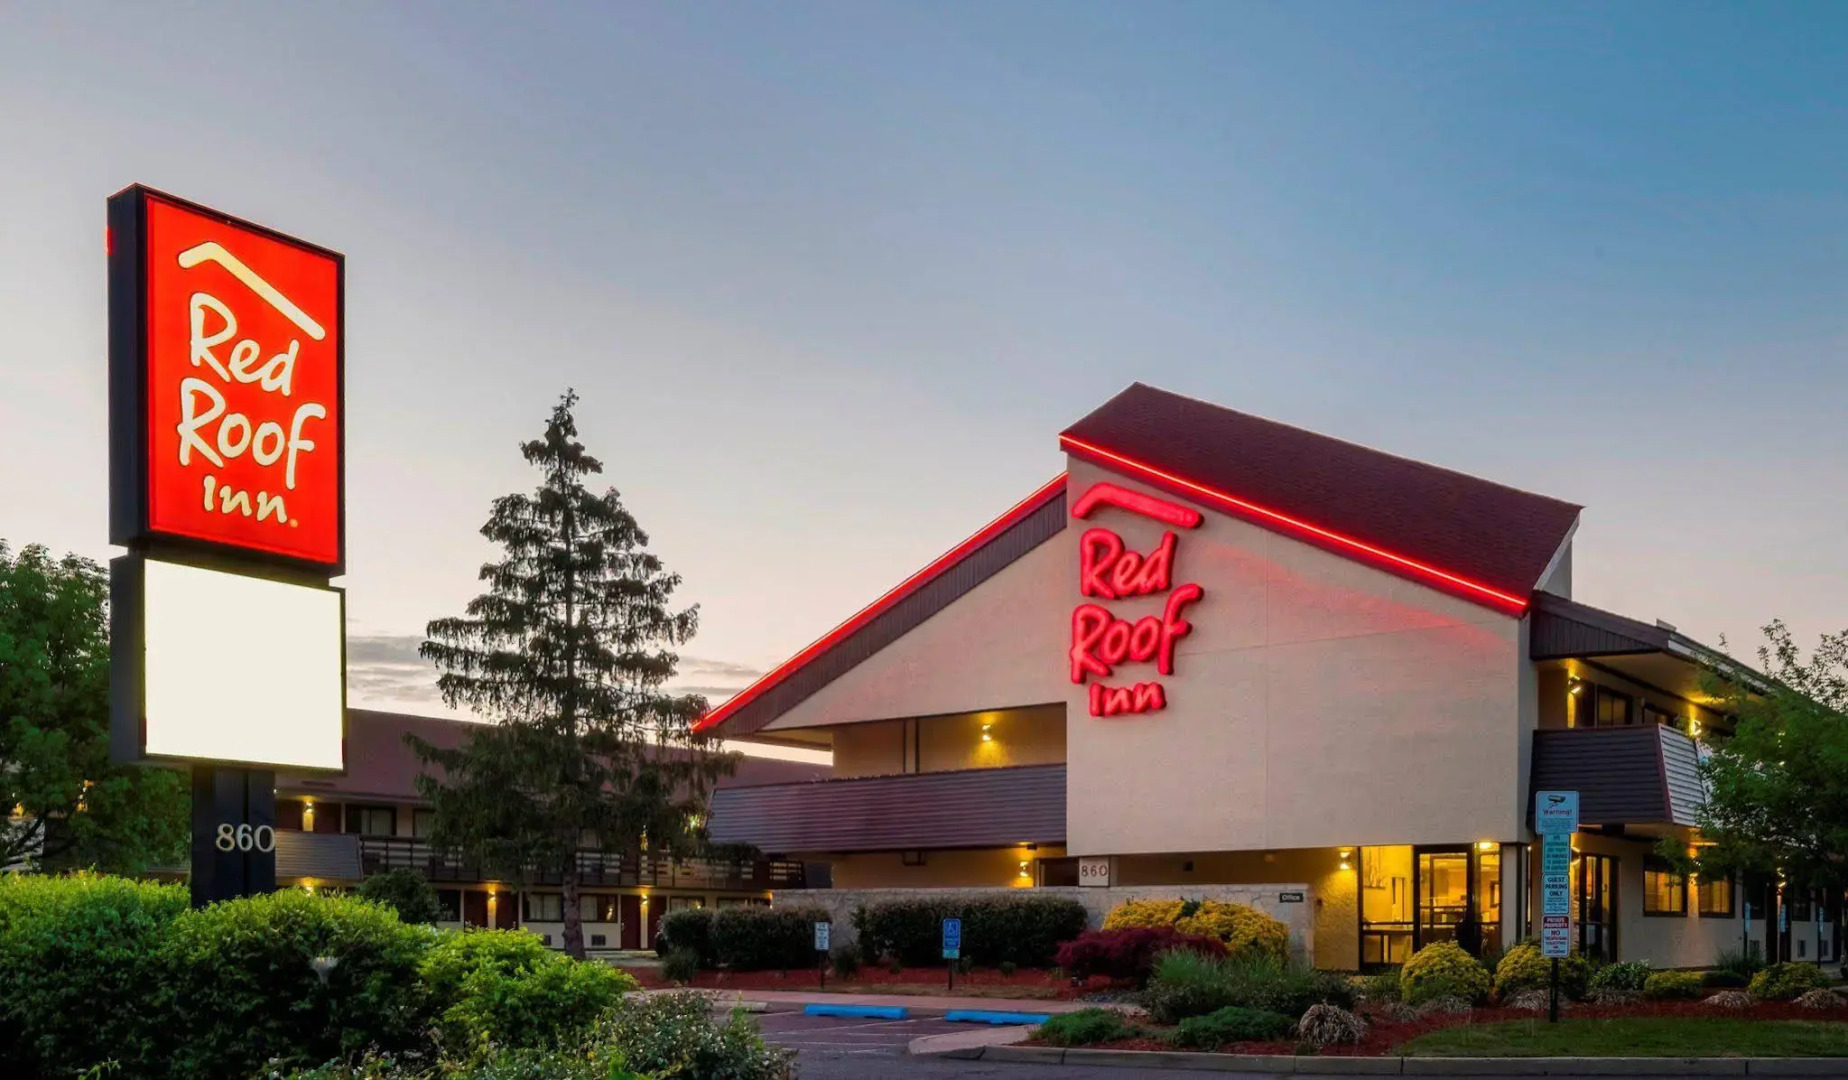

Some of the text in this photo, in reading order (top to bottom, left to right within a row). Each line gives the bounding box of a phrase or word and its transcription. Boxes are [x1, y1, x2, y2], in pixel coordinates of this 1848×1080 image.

[189, 292, 300, 397] Red
[176, 376, 326, 490] Roof
[1080, 528, 1179, 600] Red
[1070, 583, 1204, 685] Roof
[1089, 682, 1168, 718] Inn
[215, 823, 276, 853] 860
[1081, 865, 1108, 877] 860
